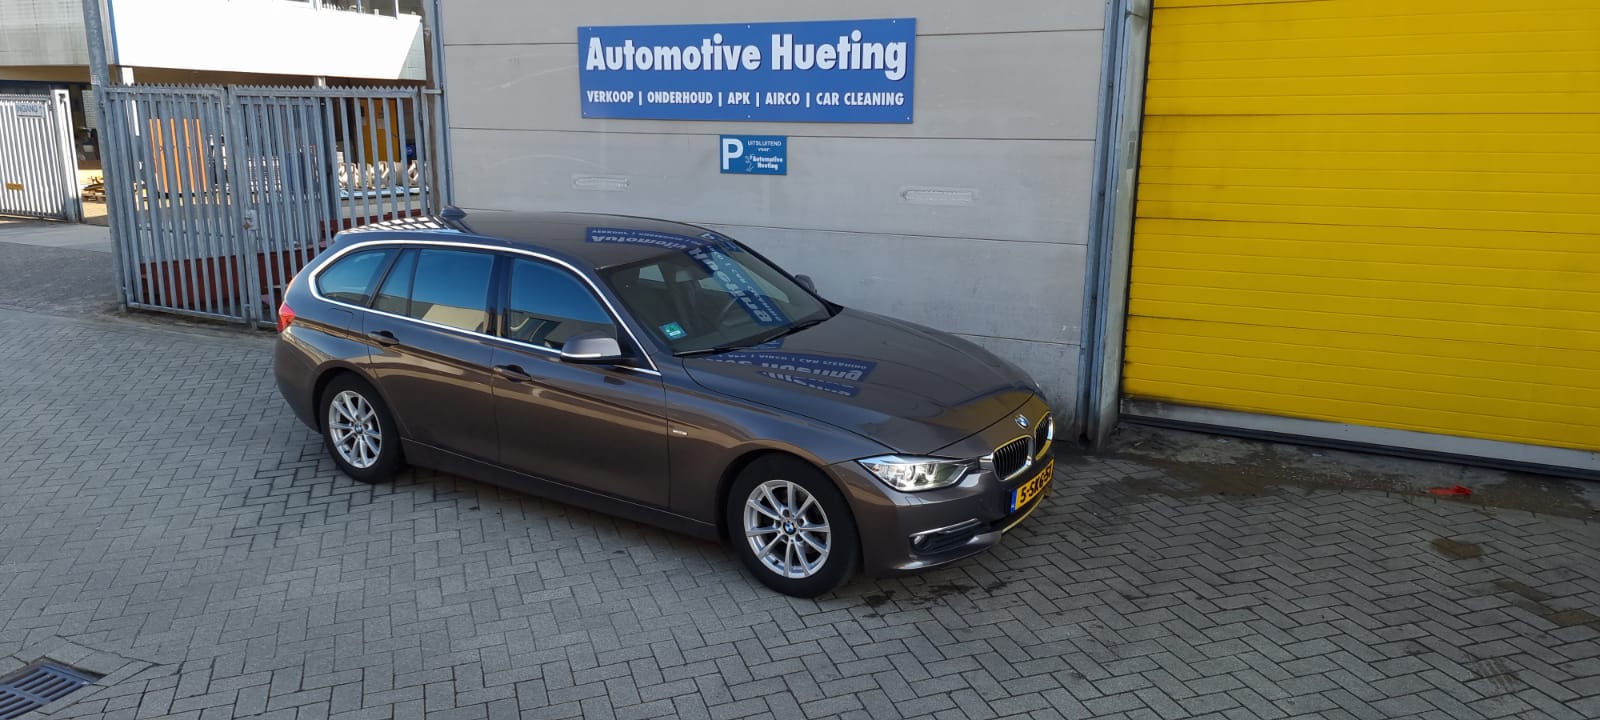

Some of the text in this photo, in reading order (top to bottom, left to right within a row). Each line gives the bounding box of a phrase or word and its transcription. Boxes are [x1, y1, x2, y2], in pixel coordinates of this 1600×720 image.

[586, 29, 907, 81] Automotive Hueting
[587, 90, 904, 106] VERKOOP ONDERHOUD APK AIRCO CAR CLEANING
[722, 138, 744, 170] P
